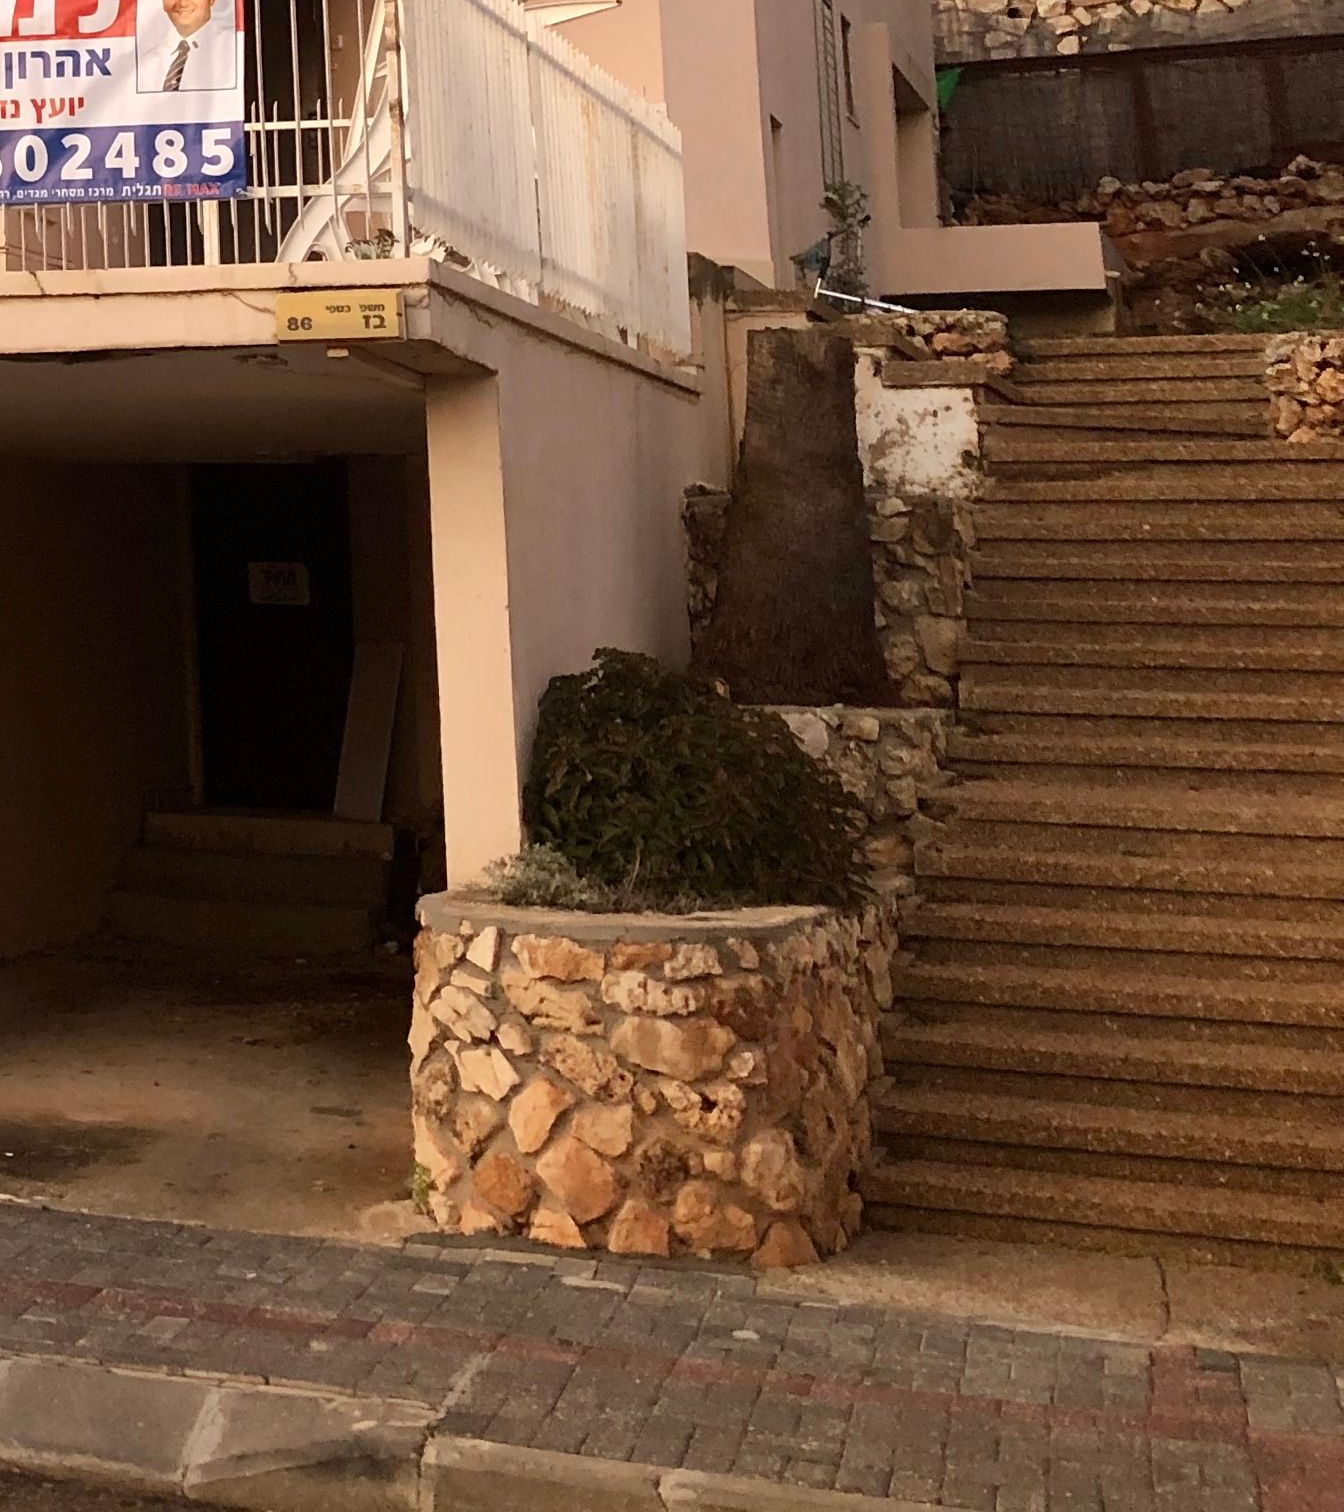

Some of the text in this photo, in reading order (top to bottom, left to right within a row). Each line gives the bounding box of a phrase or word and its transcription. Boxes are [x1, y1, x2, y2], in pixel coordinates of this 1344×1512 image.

[4, 48, 112, 89] אהרון
[30, 97, 84, 124] יועץ
[52, 188, 85, 198] מסחרי
[88, 187, 114, 197] מרכז
[122, 183, 162, 197] תגלית
[325, 304, 351, 313] כספי
[287, 314, 387, 331] בז 86
